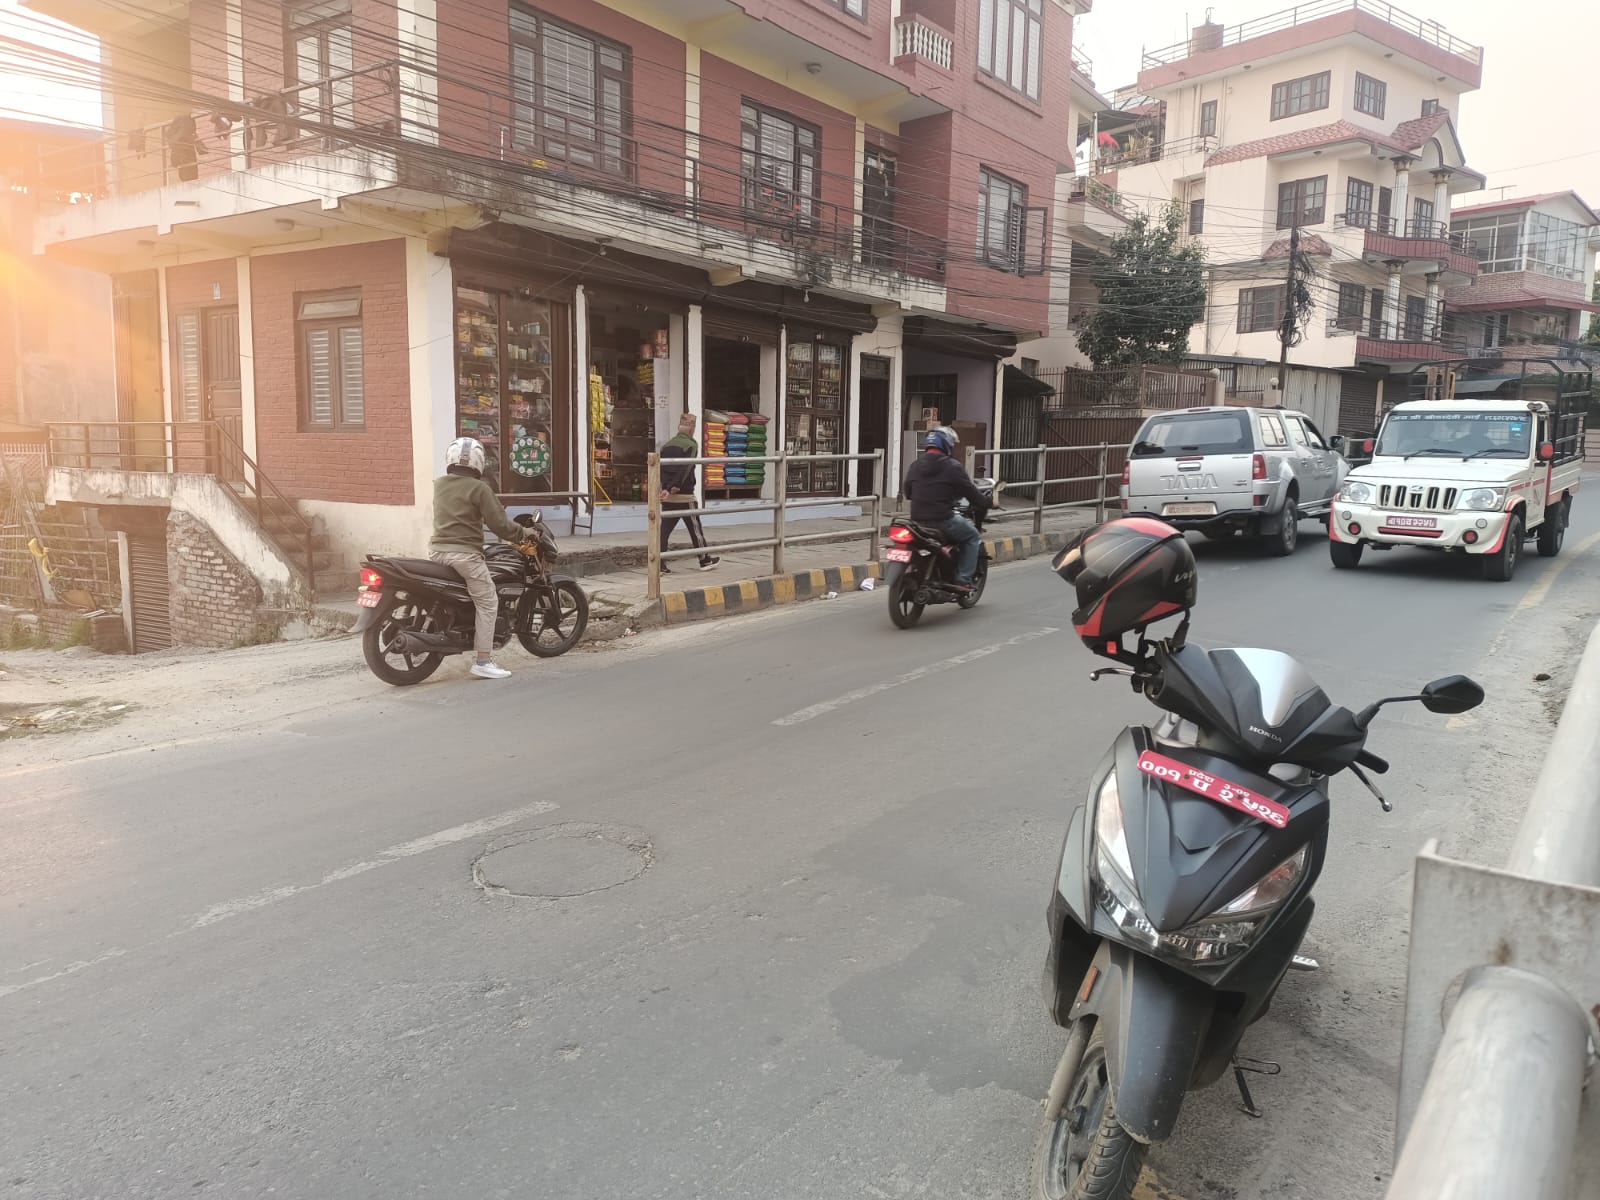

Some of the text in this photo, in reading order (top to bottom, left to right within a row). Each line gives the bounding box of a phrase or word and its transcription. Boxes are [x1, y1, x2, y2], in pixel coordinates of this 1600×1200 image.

[1159, 473, 1219, 491] TATA
[1248, 725, 1282, 743] HONDA
[1141, 760, 1181, 781] ००१
